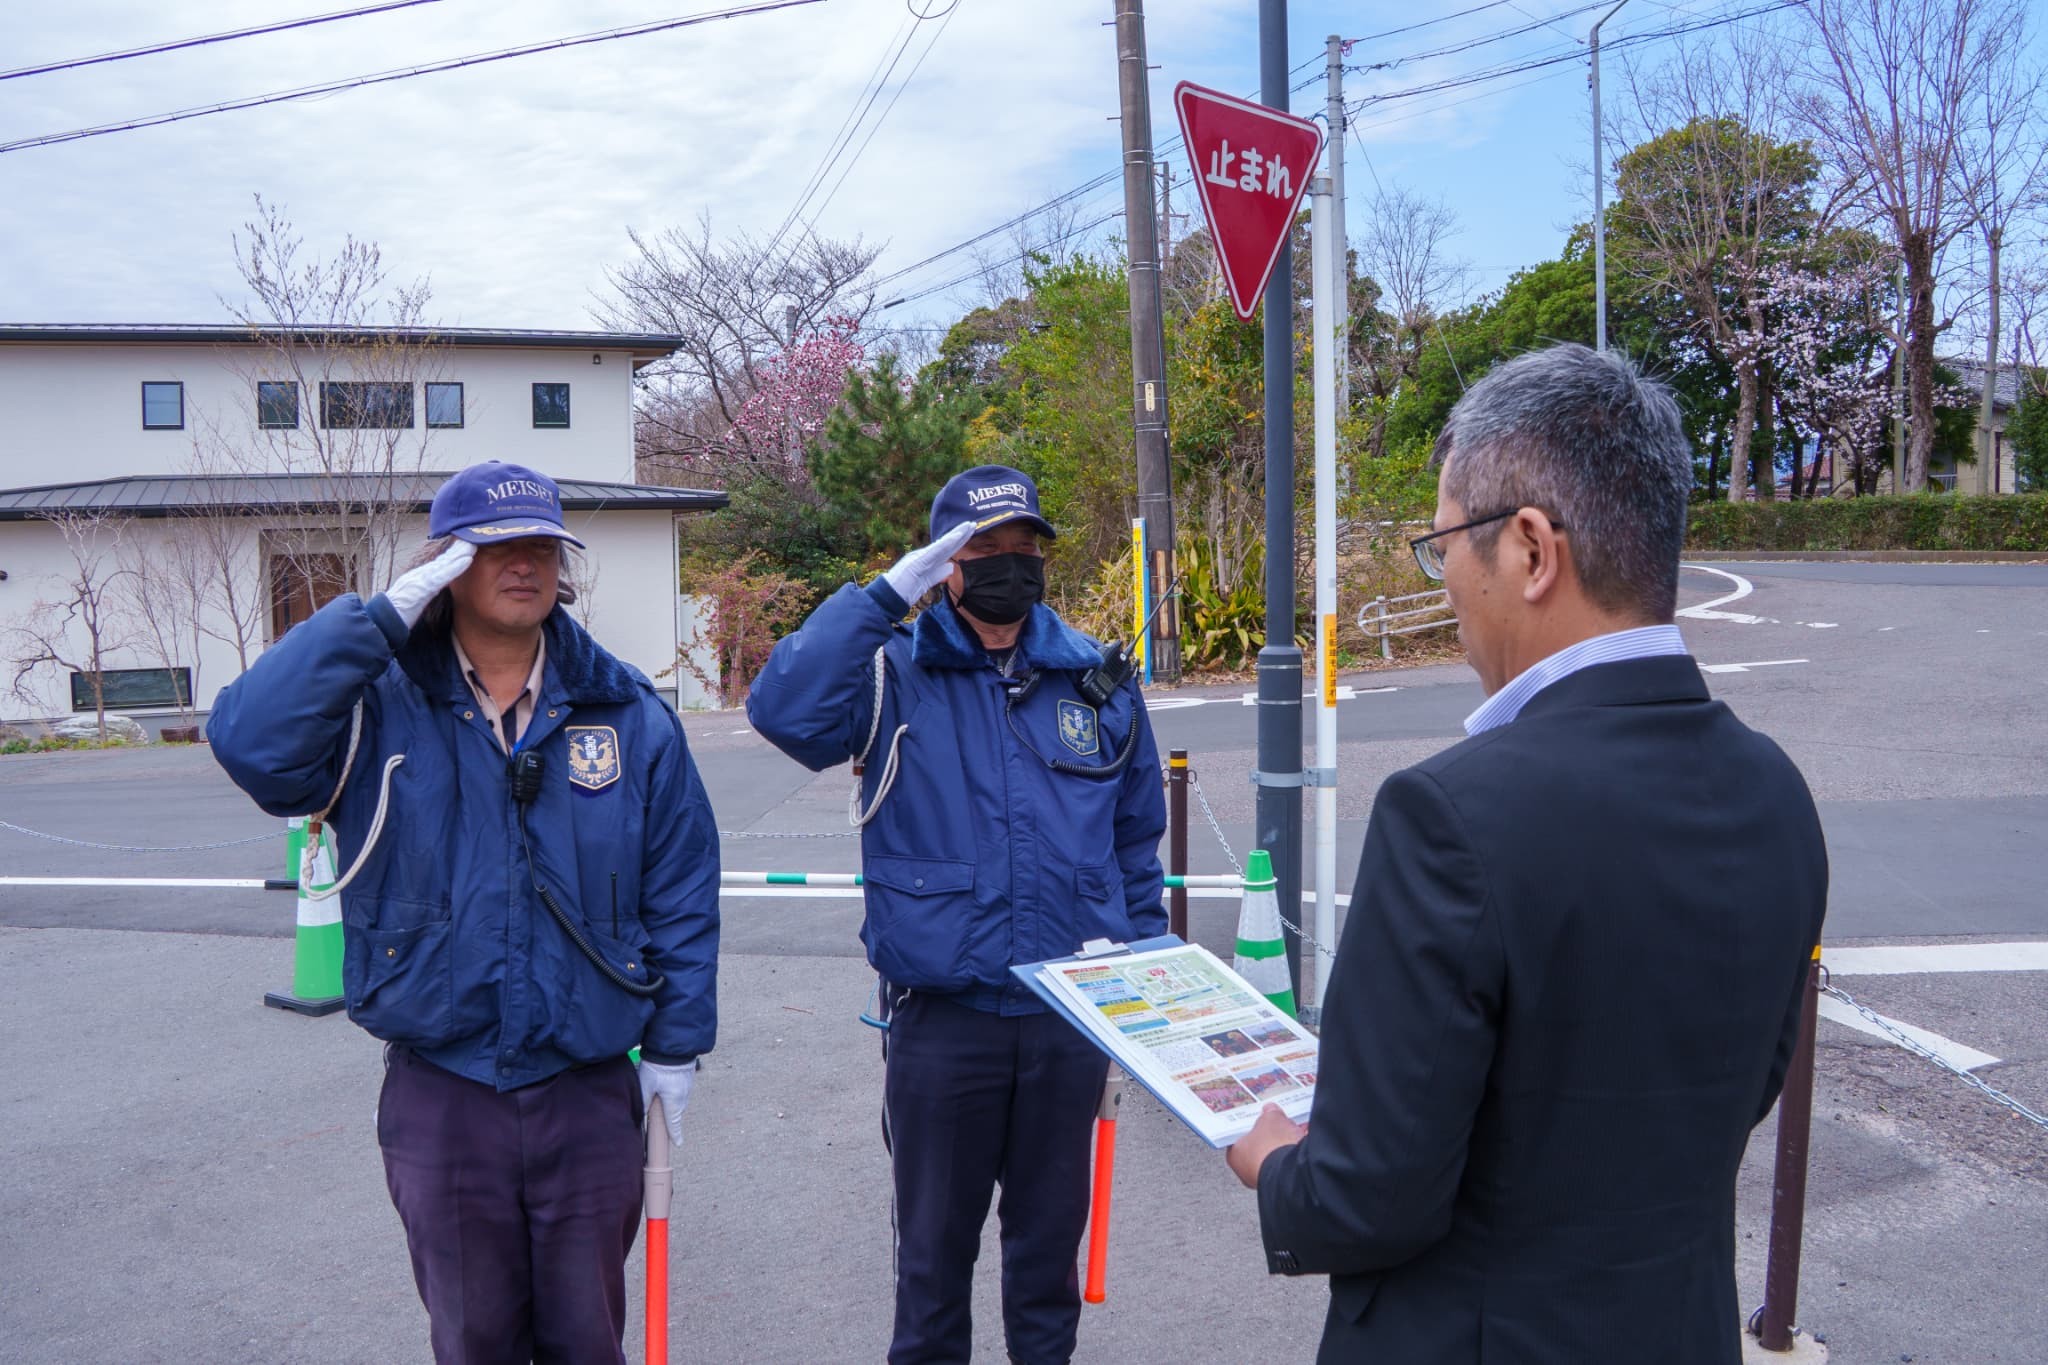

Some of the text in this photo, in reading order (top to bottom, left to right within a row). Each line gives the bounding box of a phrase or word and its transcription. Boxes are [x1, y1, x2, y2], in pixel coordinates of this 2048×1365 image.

[1206, 139, 1293, 199] 止まれ
[486, 480, 554, 507] MEISEI
[967, 483, 1029, 506] MEISEI
